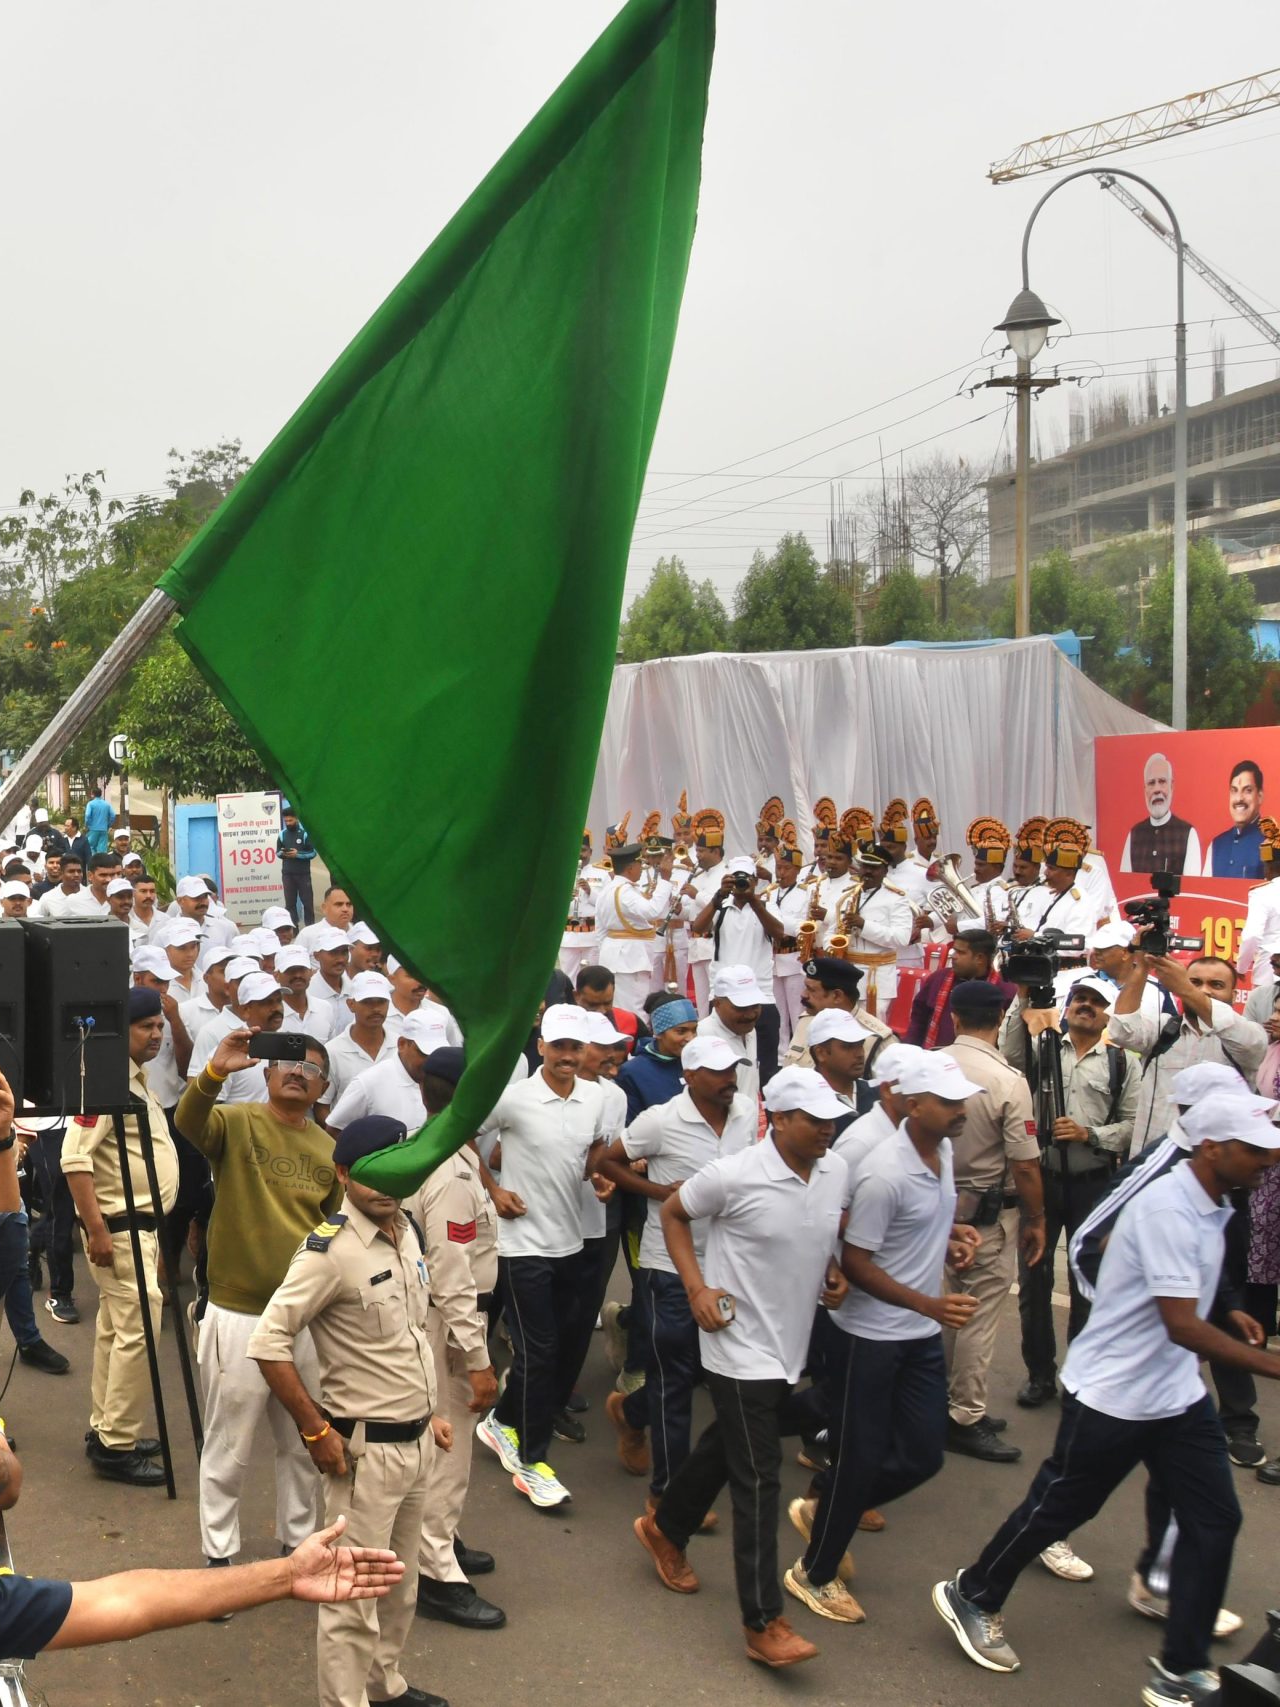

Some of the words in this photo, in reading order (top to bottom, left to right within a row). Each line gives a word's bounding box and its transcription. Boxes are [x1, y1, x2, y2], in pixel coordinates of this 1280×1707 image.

[229, 847, 275, 865] 1930
[1200, 916, 1245, 961] 193
[247, 1145, 336, 1186] Polo
